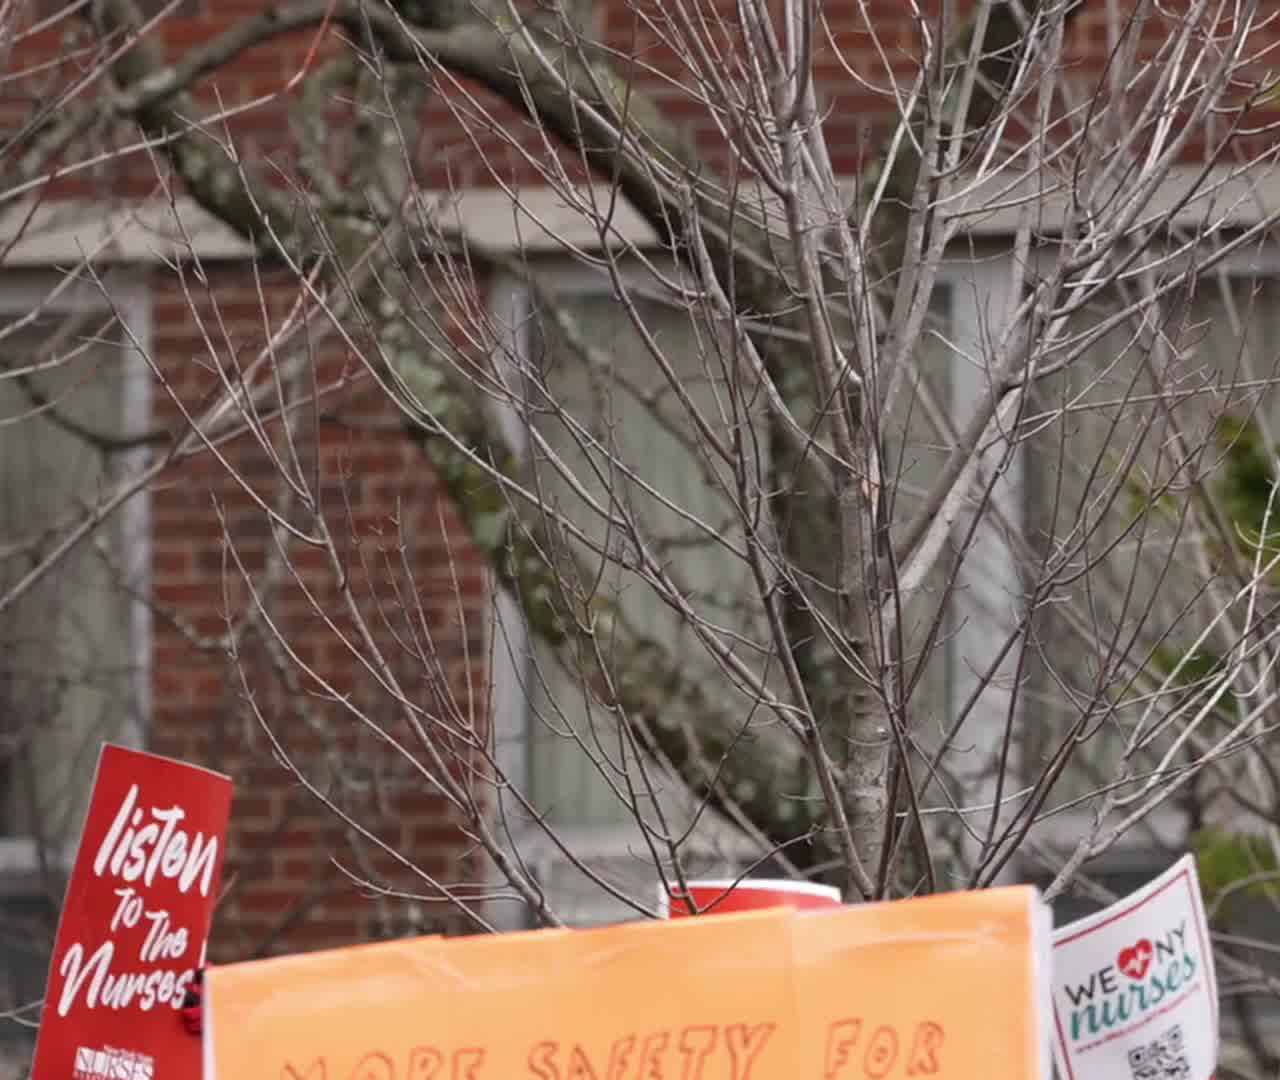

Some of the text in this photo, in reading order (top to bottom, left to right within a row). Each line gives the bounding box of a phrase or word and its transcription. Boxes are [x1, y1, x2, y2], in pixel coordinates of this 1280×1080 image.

[57, 939, 193, 1018] Nurses
[1064, 920, 1189, 1007] WE NY
[1070, 950, 1197, 1041] nurses
